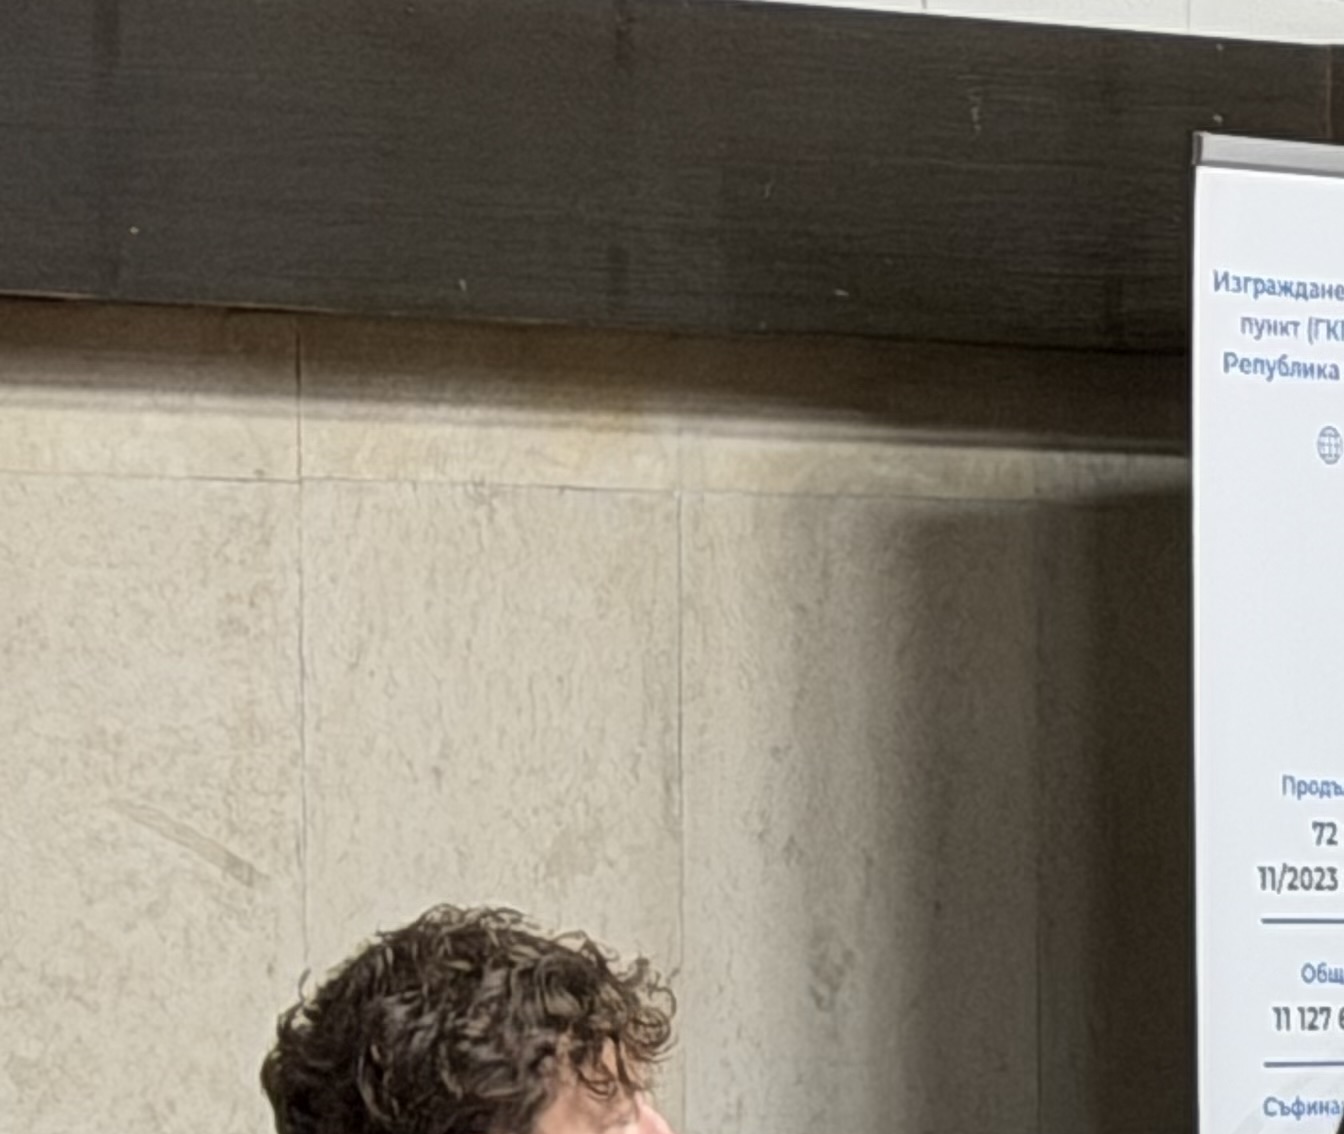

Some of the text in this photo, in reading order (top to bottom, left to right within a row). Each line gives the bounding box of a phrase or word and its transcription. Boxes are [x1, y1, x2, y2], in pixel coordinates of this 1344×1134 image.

[1240, 316, 1300, 340] пункт
[1223, 352, 1340, 382] Република
[1312, 820, 1338, 846] 72
[1257, 863, 1339, 894] 11/2023
[1272, 1006, 1291, 1032] 11
[1297, 1006, 1331, 1032] 127
